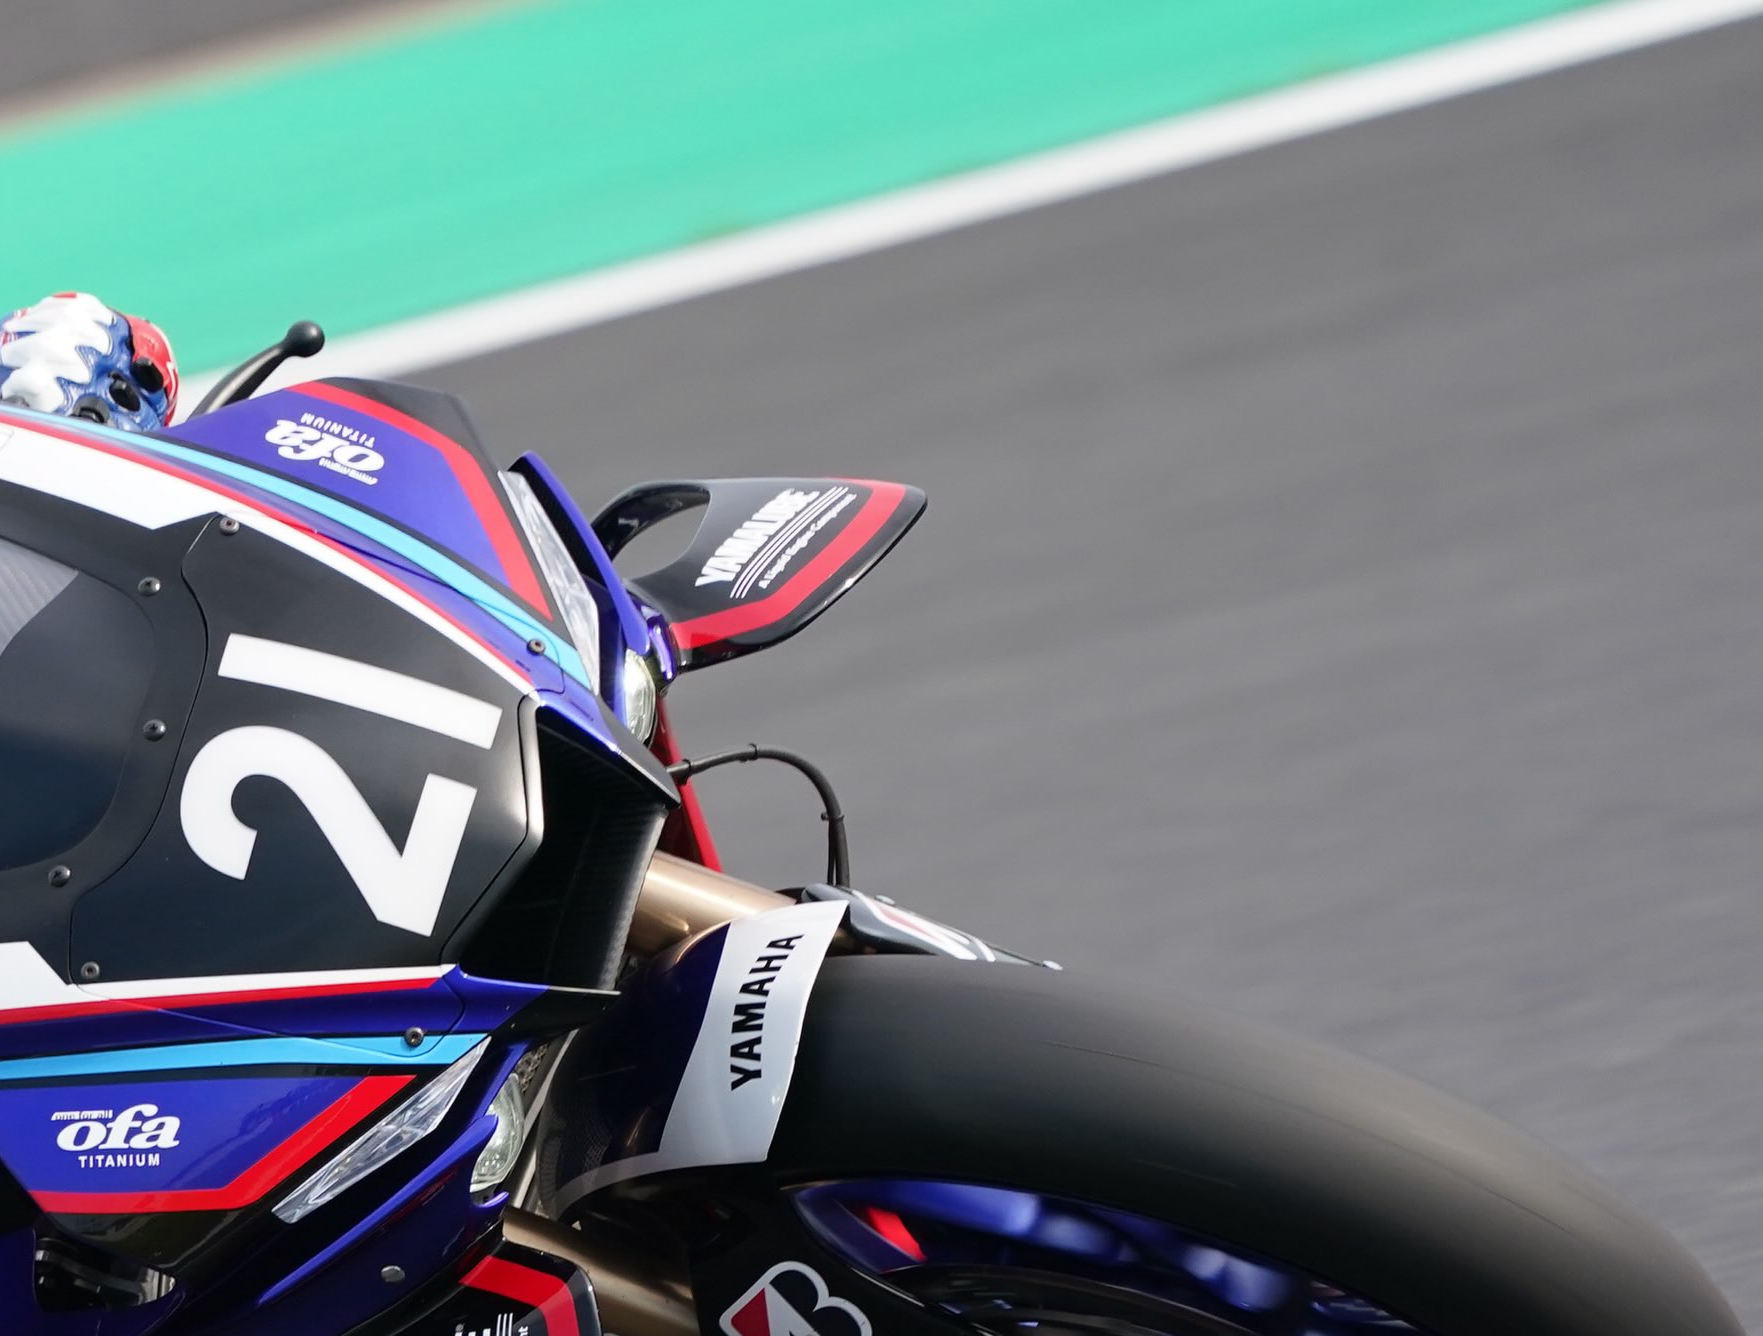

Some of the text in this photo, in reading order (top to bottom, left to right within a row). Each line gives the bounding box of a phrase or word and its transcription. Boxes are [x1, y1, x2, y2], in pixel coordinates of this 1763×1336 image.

[265, 419, 384, 471] ofa
[300, 412, 375, 448] TITANIUM
[180, 632, 503, 937] 21
[730, 934, 805, 1091] YAMAHA
[57, 1103, 180, 1151] ofa
[78, 1153, 160, 1168] TITANIUM
